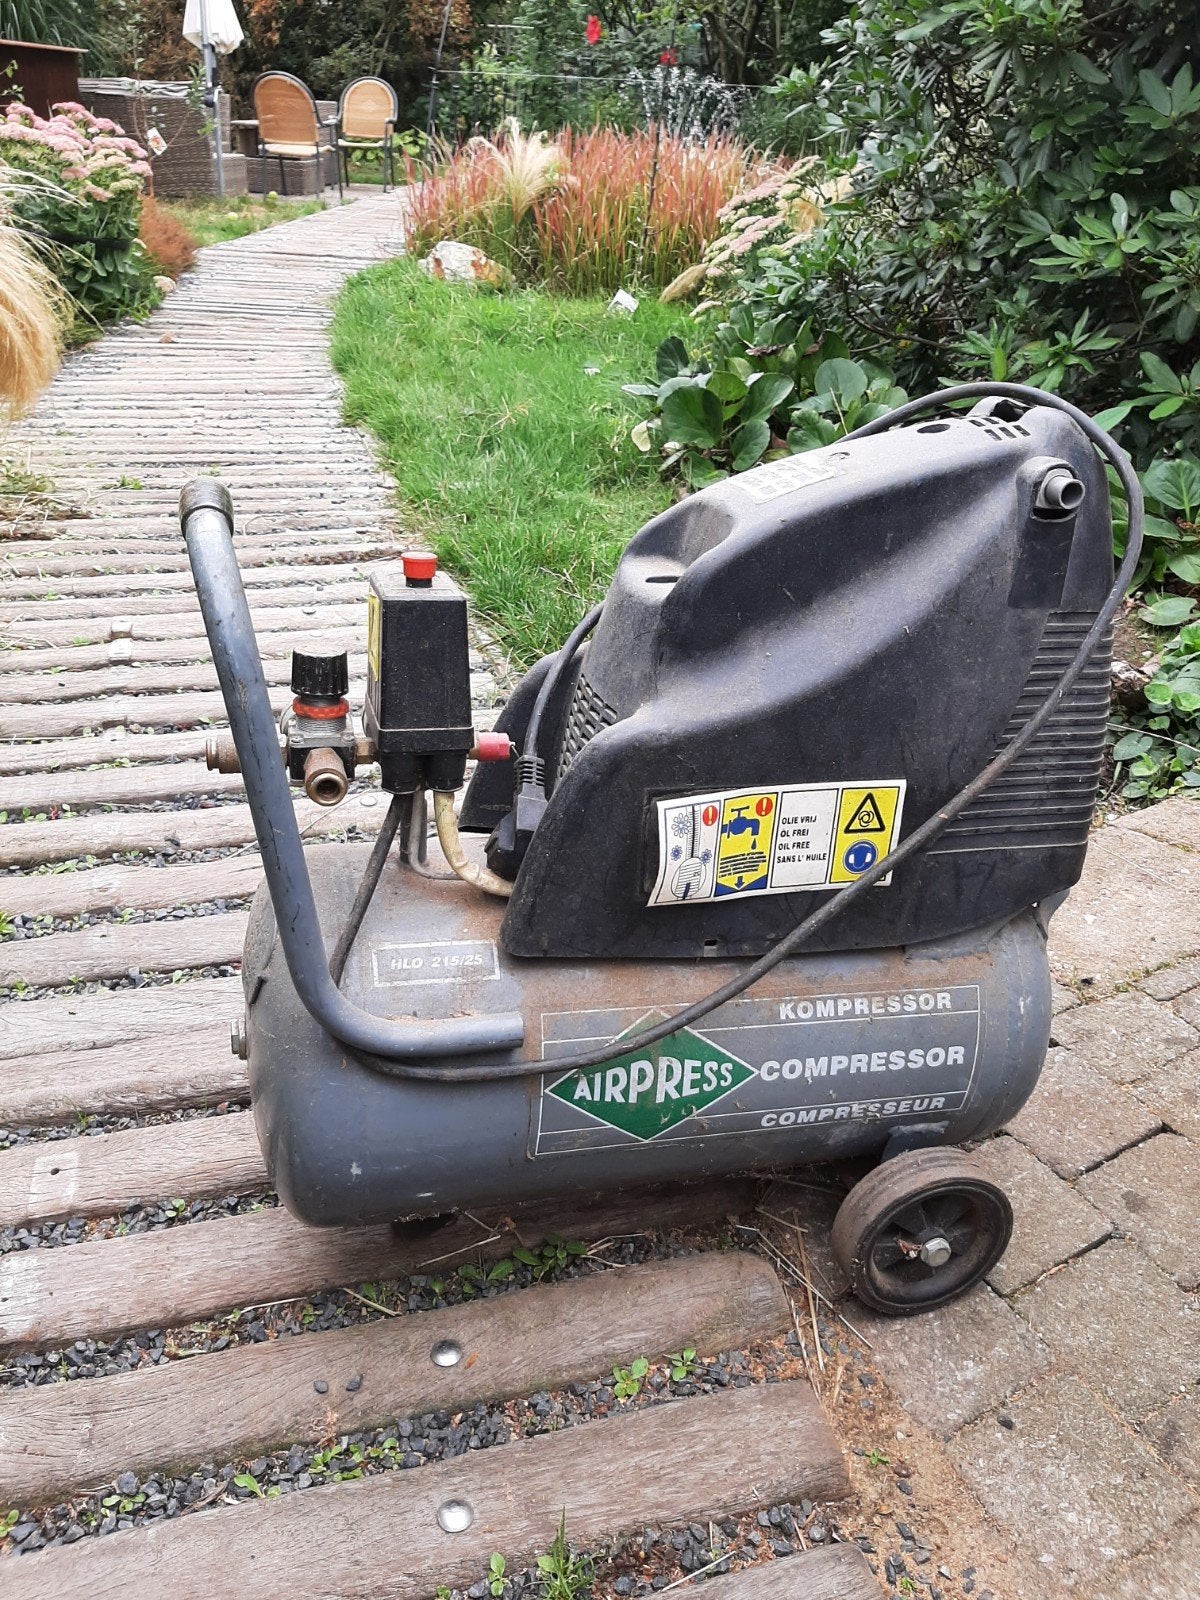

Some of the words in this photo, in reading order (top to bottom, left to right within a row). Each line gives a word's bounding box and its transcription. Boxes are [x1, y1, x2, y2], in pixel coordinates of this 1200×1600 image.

[781, 816, 799, 825] OLIE
[800, 815, 817, 823] VRIJ
[792, 828, 809, 837] FREI
[792, 841, 810, 849] FREE
[776, 855, 796, 864] SANS
[805, 853, 827, 861] HUILE
[389, 957, 424, 970] HLO
[430, 954, 483, 968] 215/25
[779, 992, 952, 1019] KOMPRESSOR
[760, 1045, 965, 1081] COMPRESSOR
[573, 1056, 733, 1104] AIRPRESS
[760, 1097, 946, 1127] COMPRESSEUR
